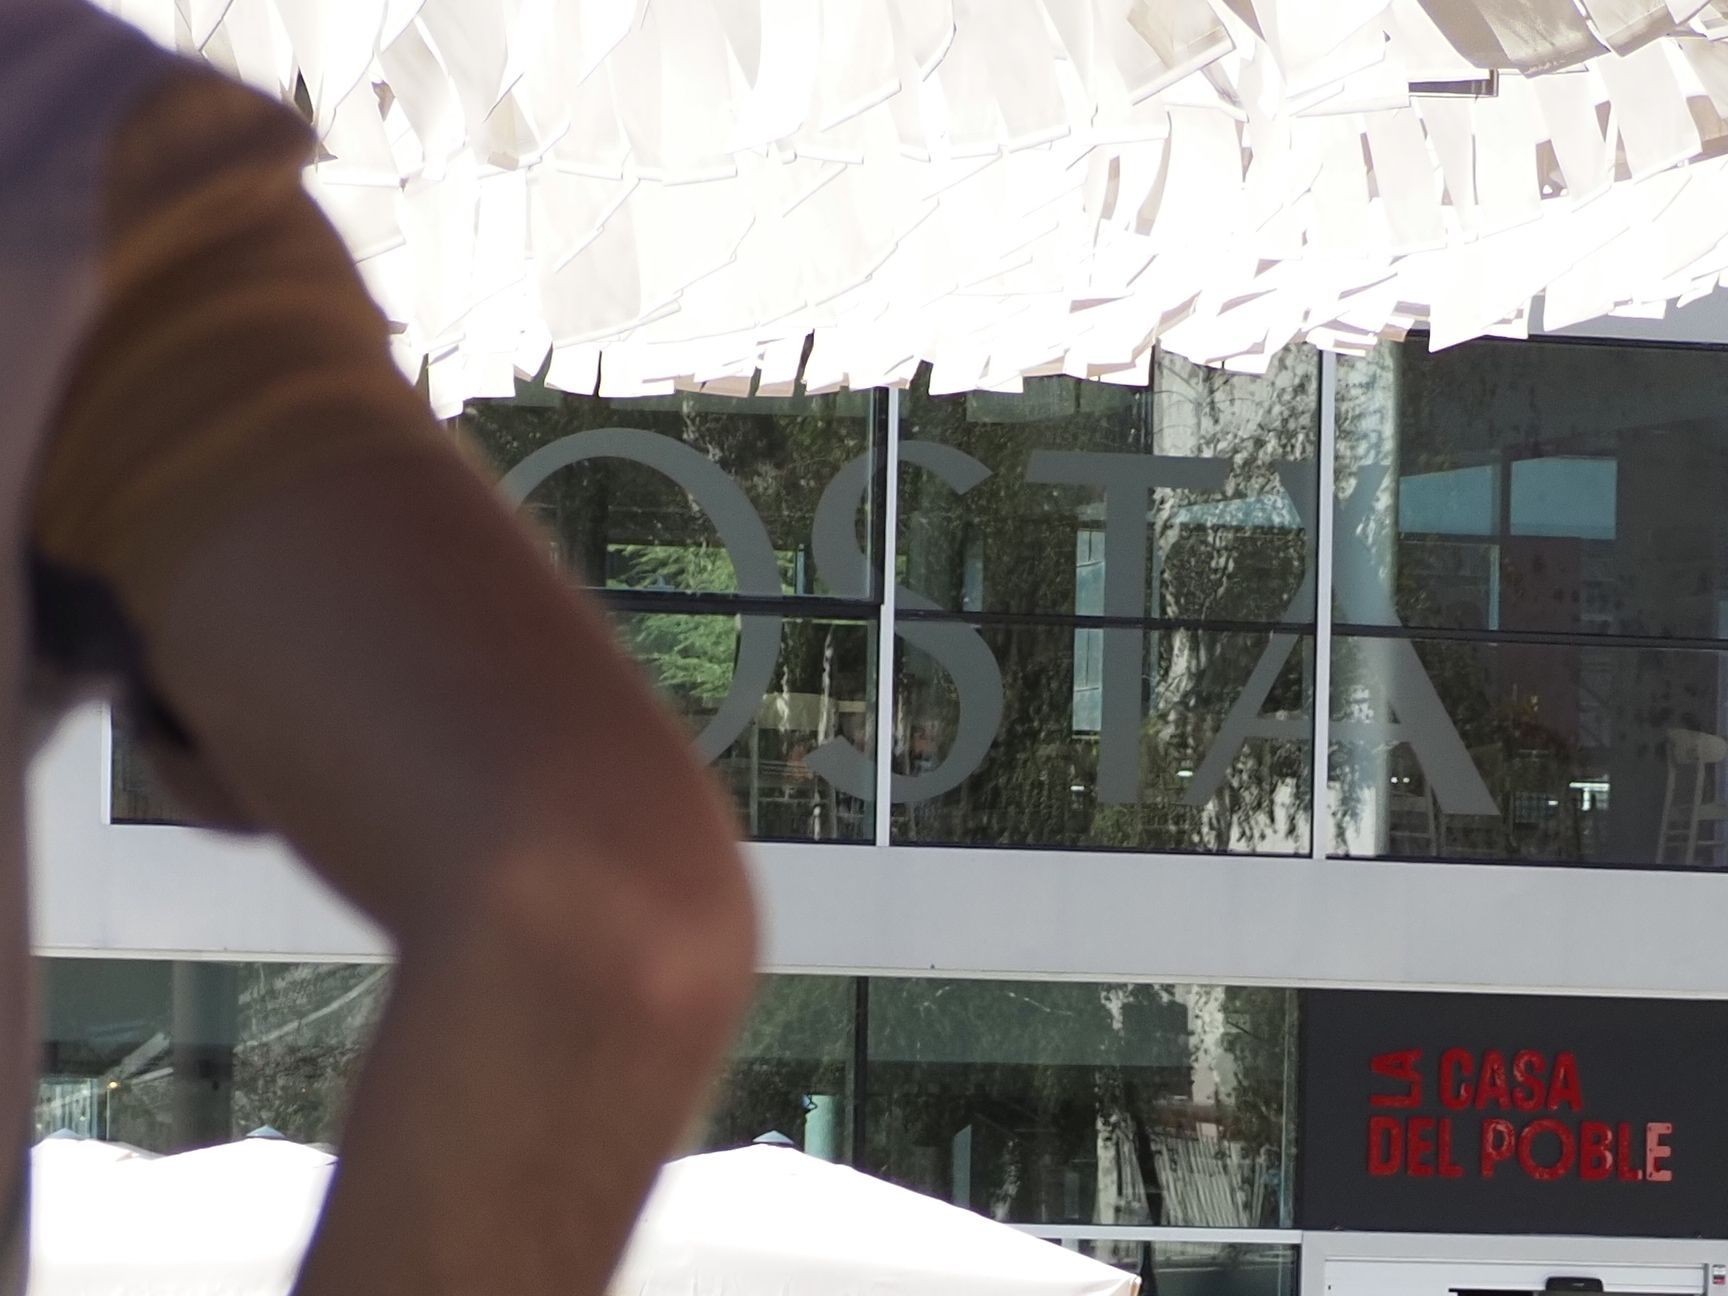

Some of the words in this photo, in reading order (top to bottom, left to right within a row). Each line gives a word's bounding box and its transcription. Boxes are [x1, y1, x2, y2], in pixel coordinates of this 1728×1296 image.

[1369, 1047, 1425, 1109] LA
[1438, 1046, 1584, 1113] CASA
[1367, 1115, 1465, 1178] DEL
[1479, 1117, 1674, 1183] POBLE
